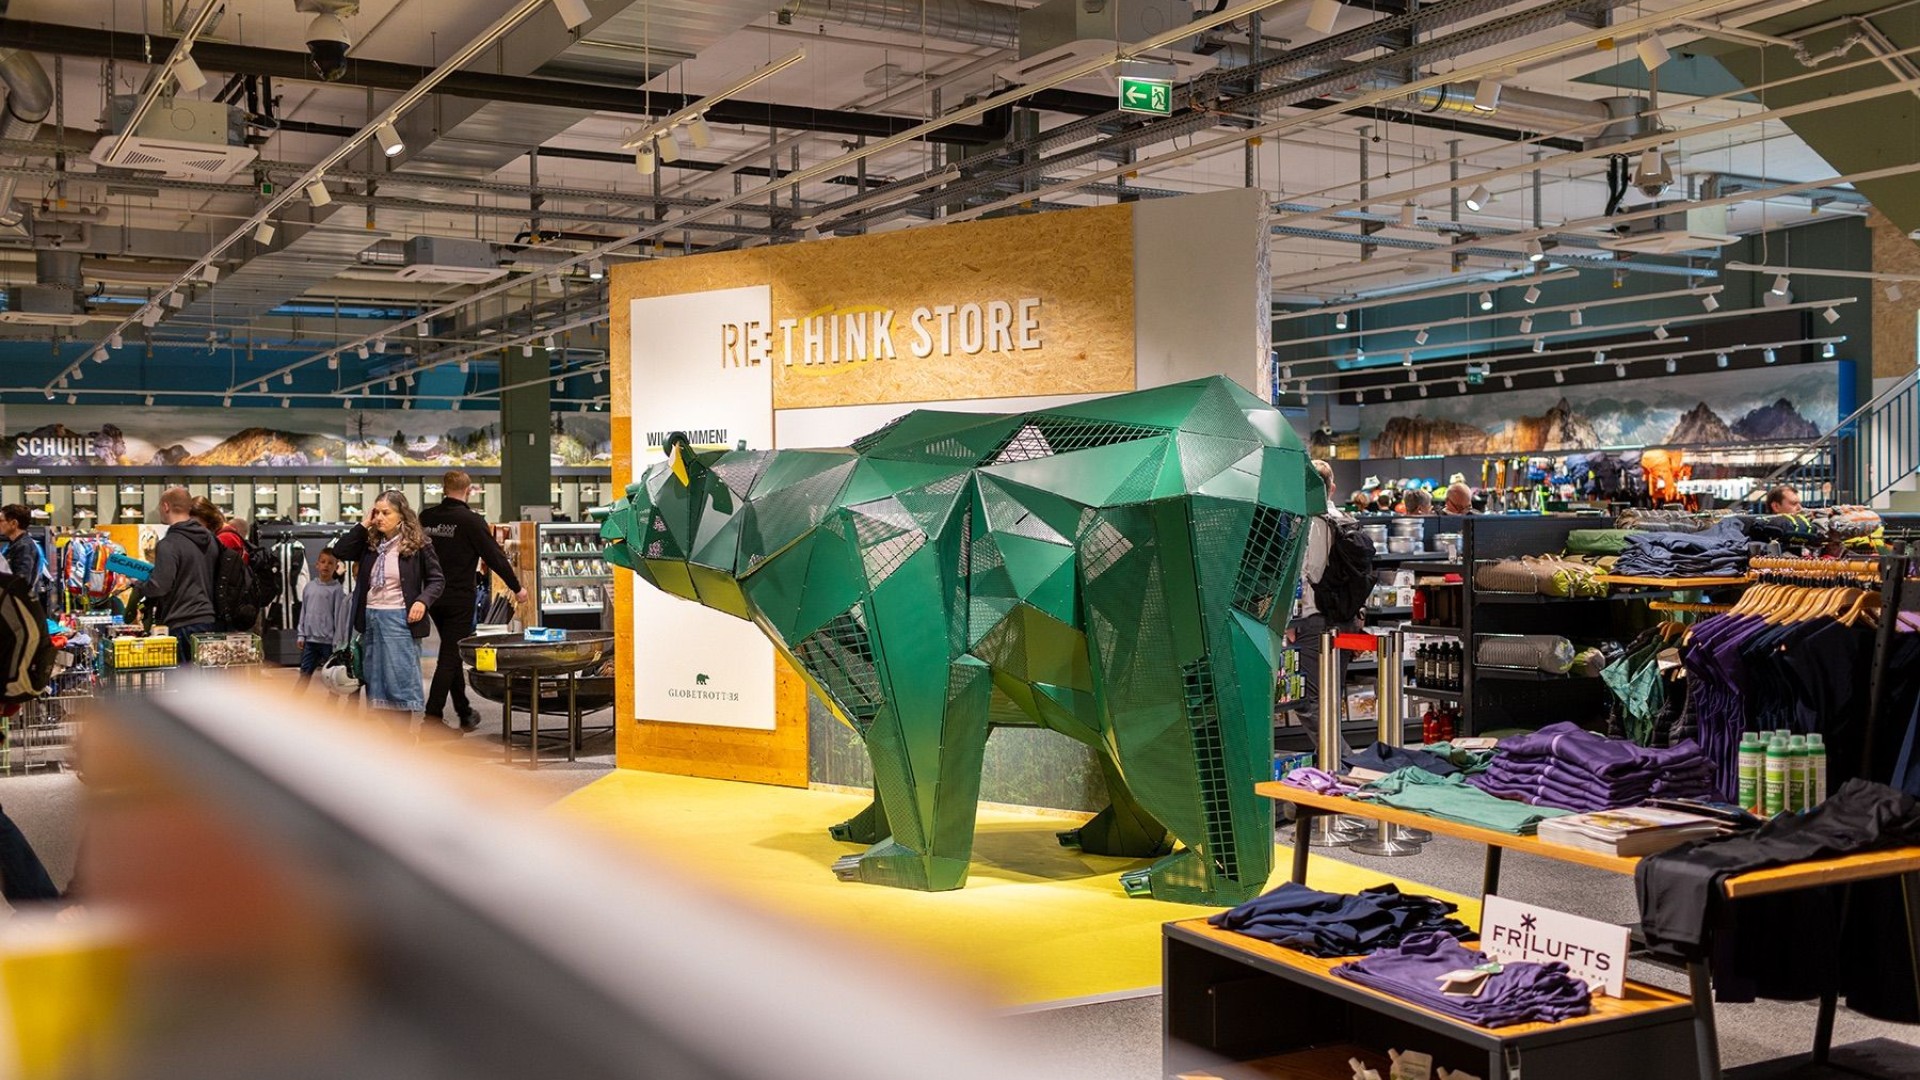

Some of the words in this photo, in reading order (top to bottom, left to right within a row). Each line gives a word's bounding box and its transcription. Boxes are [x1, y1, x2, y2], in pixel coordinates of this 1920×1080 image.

[911, 297, 1043, 359] STORE
[16, 437, 95, 457] SCHUHE
[646, 429, 727, 447] WILMMEN!
[1492, 914, 1611, 971] FRILUFTS
